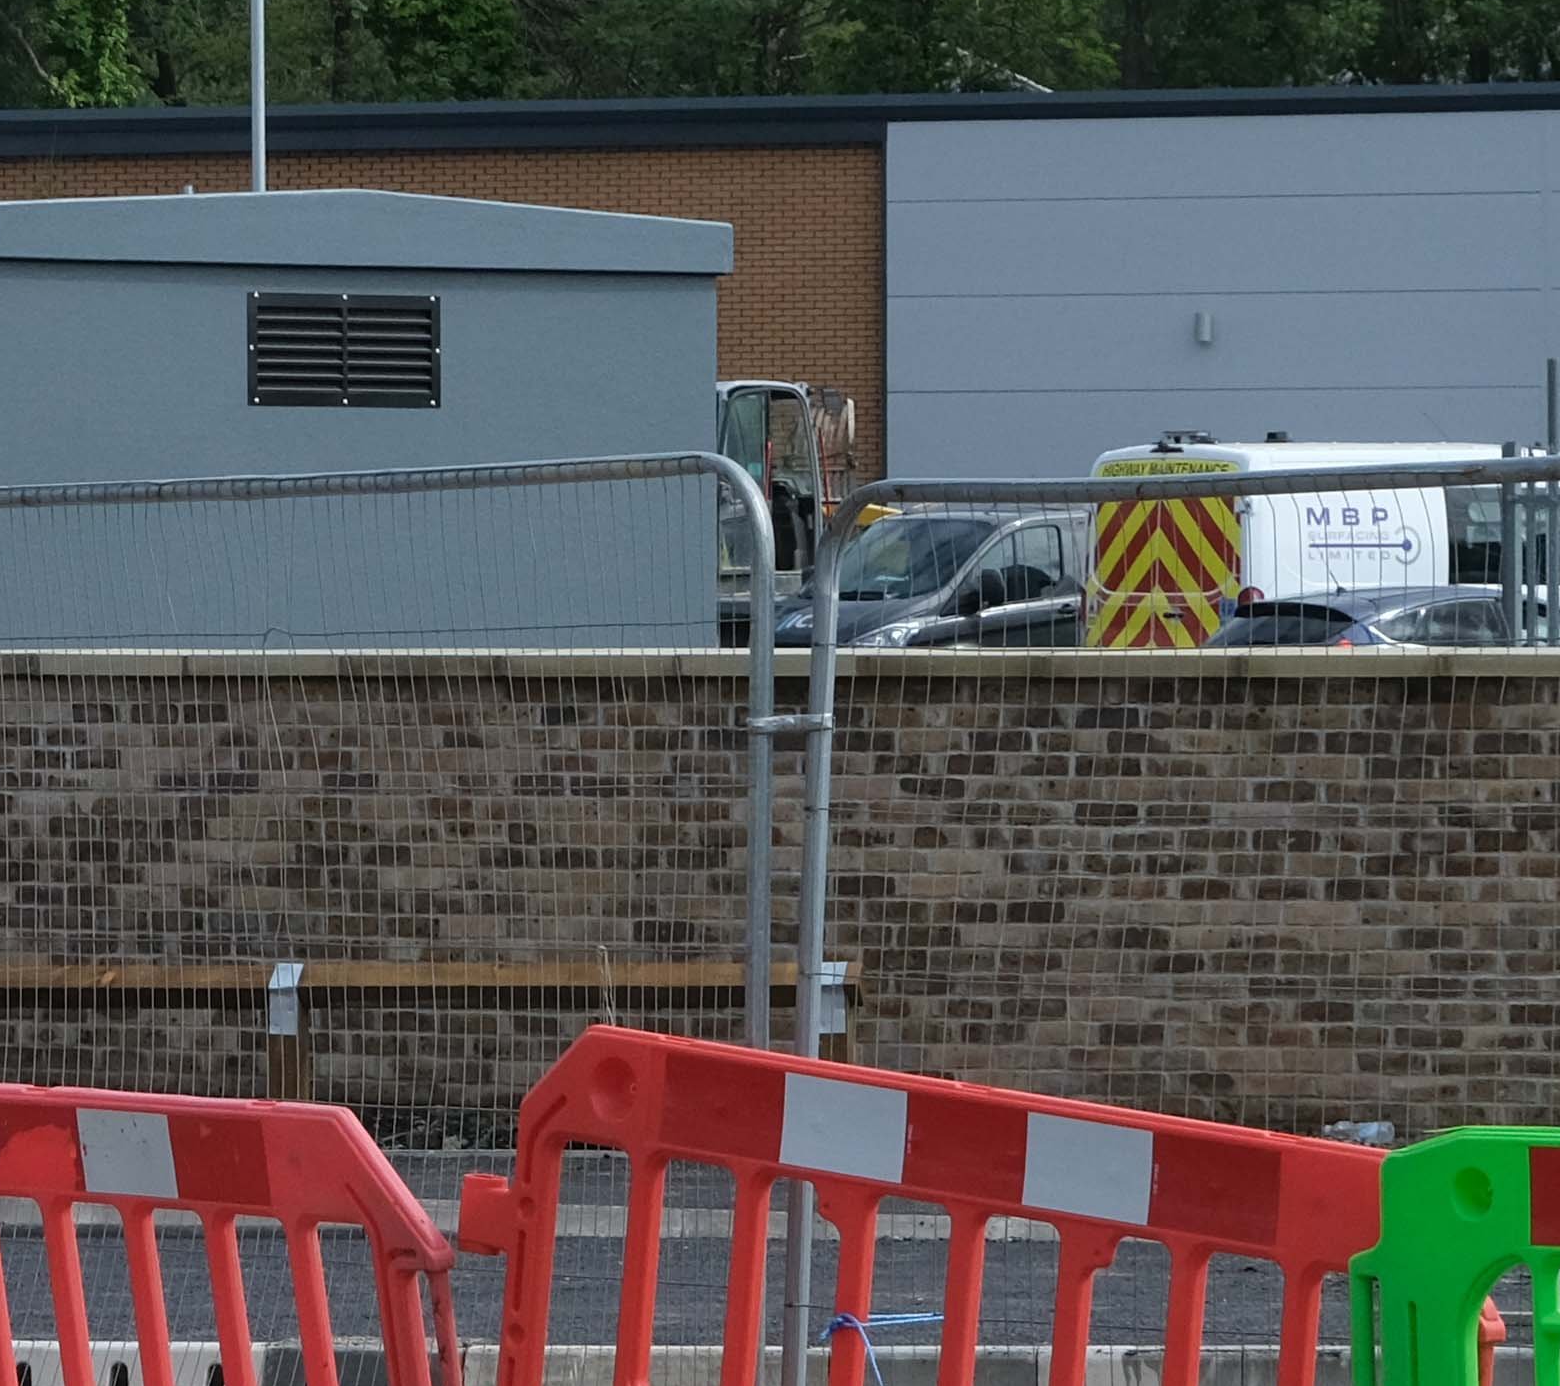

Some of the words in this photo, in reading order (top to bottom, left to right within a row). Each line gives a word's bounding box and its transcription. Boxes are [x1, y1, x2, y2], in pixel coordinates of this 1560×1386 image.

[1149, 462, 1230, 475] MAINTENANCE
[1306, 507, 1389, 526] MBP
[1308, 550, 1391, 561] LIMITED
